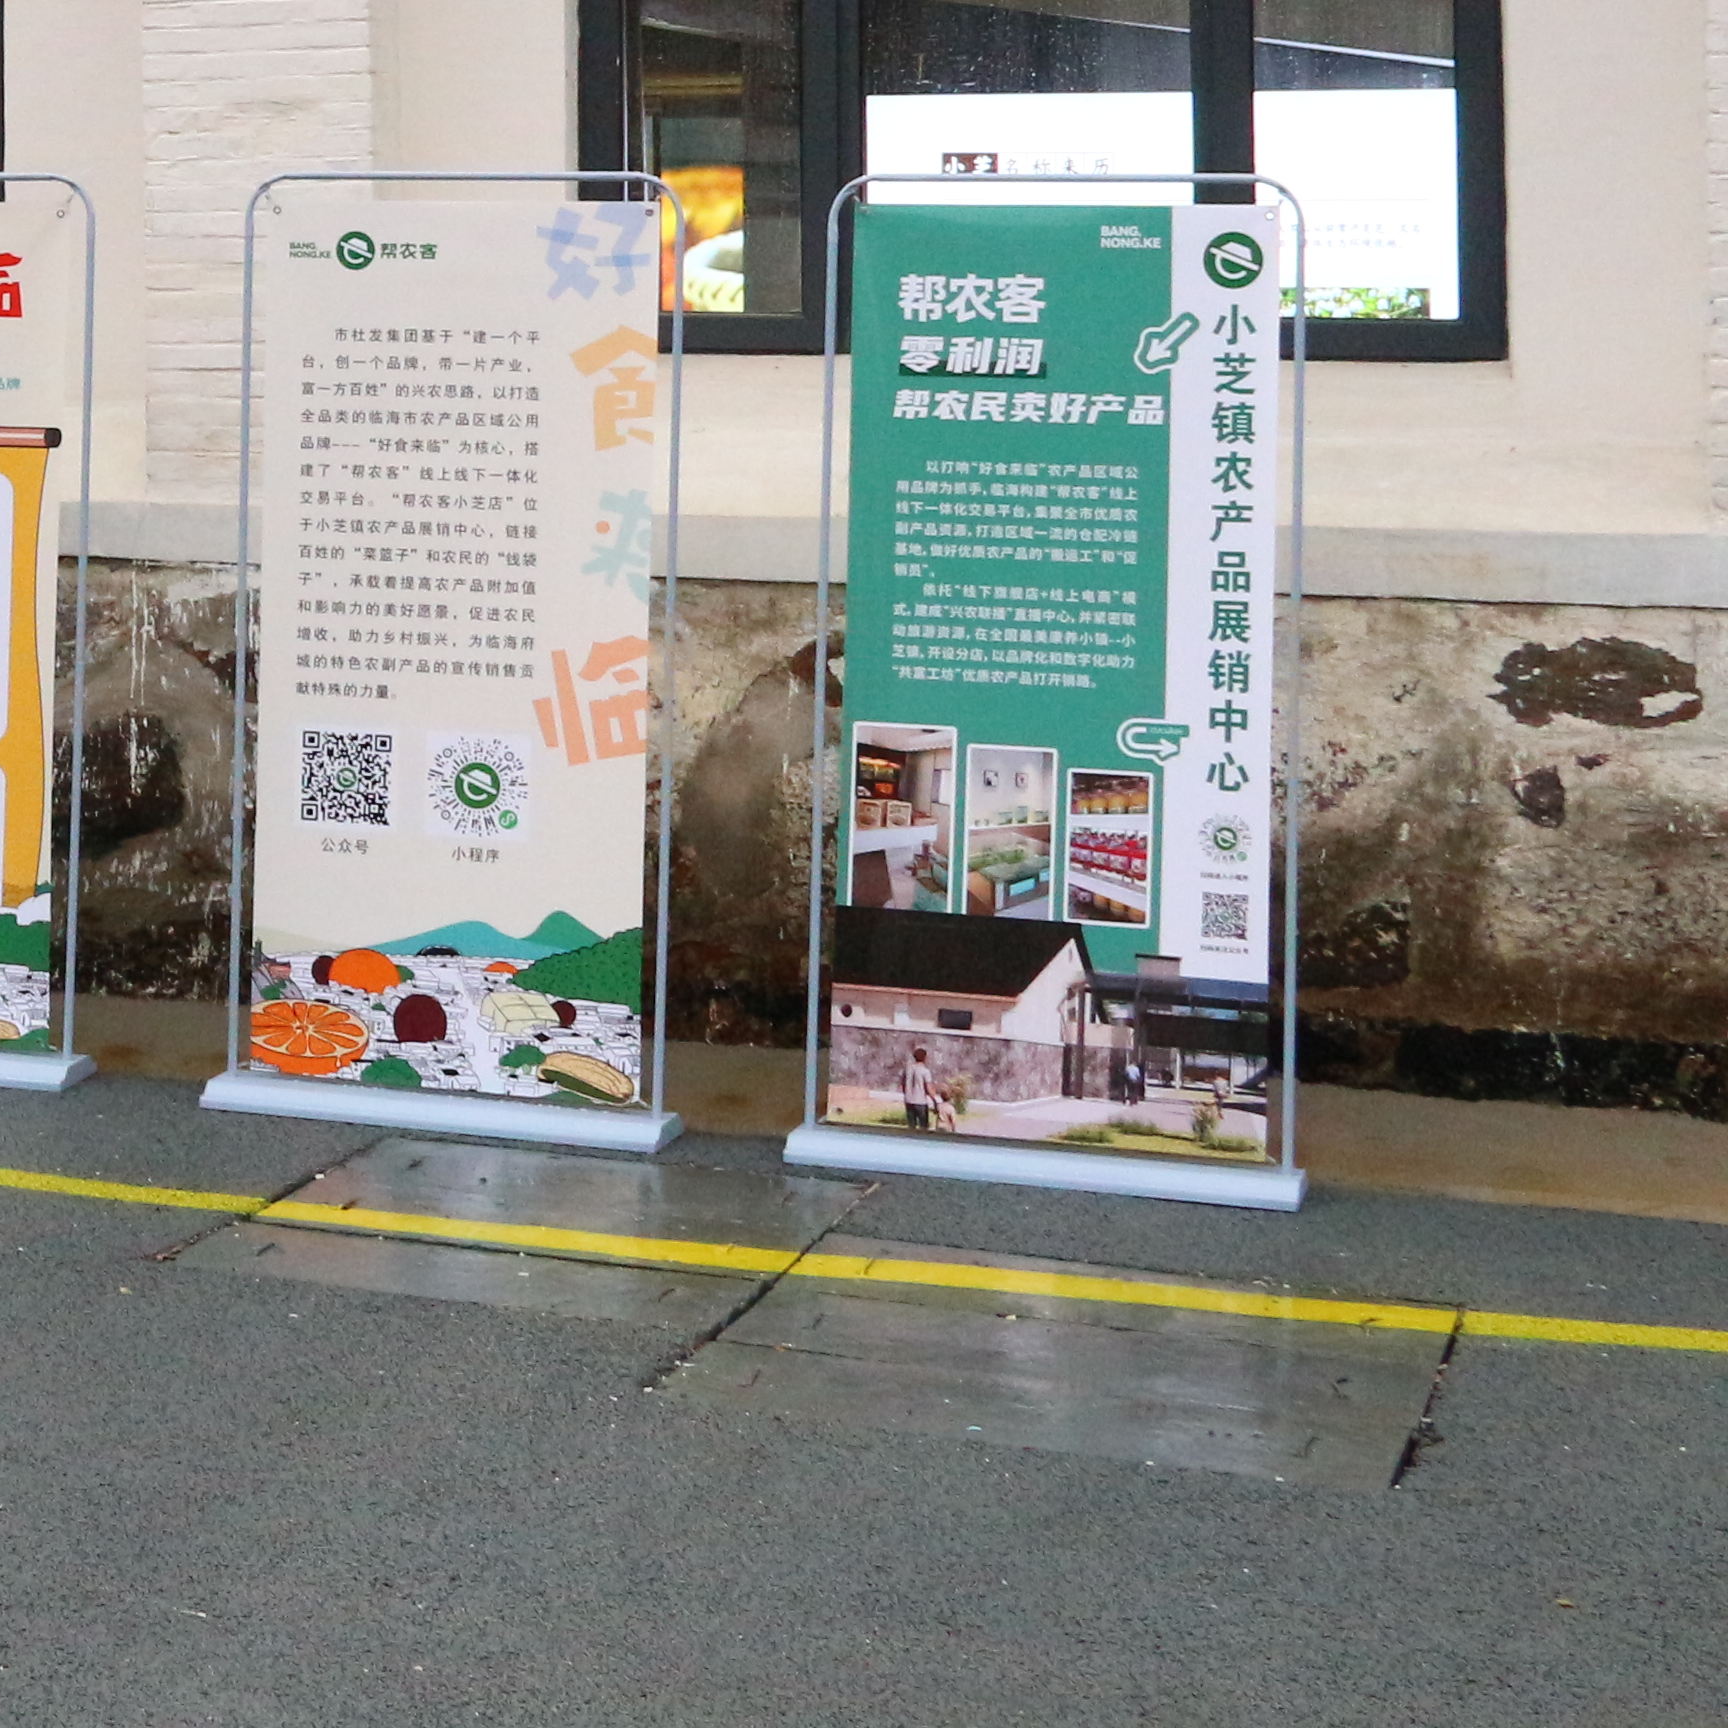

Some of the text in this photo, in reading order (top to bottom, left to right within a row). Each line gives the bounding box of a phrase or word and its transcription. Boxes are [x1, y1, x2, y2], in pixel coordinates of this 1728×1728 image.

[380, 242, 438, 260] 帮农客
[898, 273, 1046, 323] 帮农客
[900, 335, 1045, 376] 零利润
[300, 408, 540, 428] 全品类的临海市农产品区域公用
[893, 389, 1165, 426] 帮农民卖好产品
[1206, 304, 1257, 792] 小芝镇农产品展销中心
[295, 653, 534, 679] 城的特色农副产品的宣传销售贡
[321, 837, 369, 855] 公众号
[452, 846, 501, 864] 小程序
